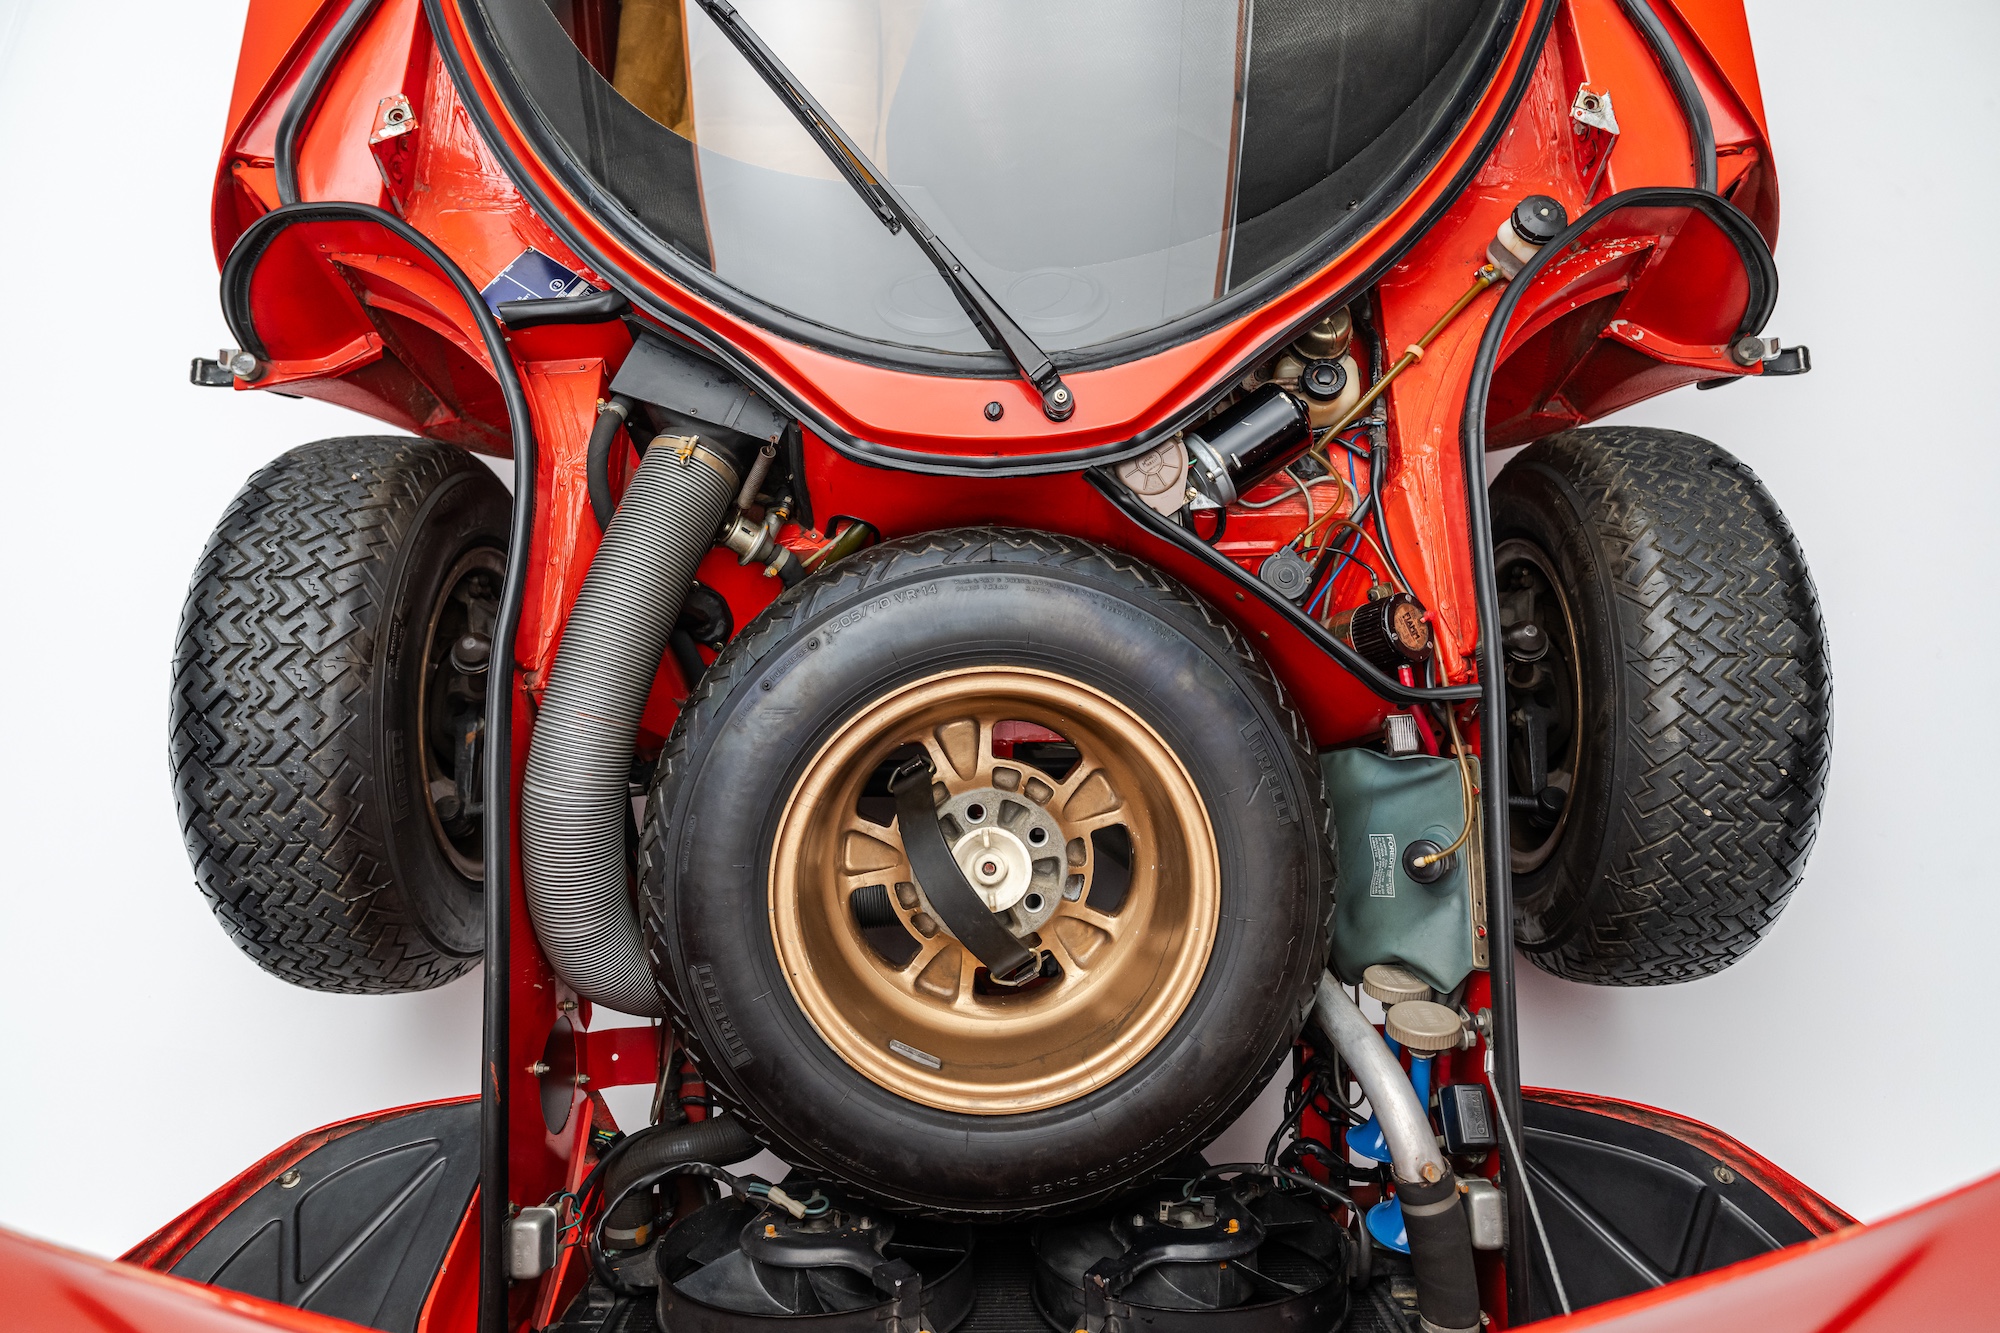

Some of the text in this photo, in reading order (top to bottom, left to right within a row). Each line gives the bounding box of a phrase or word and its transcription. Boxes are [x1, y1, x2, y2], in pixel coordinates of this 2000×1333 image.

[829, 583, 937, 633] 205/70 VR 14
[768, 645, 809, 681] tubeless
[1240, 717, 1299, 826] PIRELLI
[1386, 837, 1395, 868] FOREDIT
[689, 964, 754, 1070] PIRELLI
